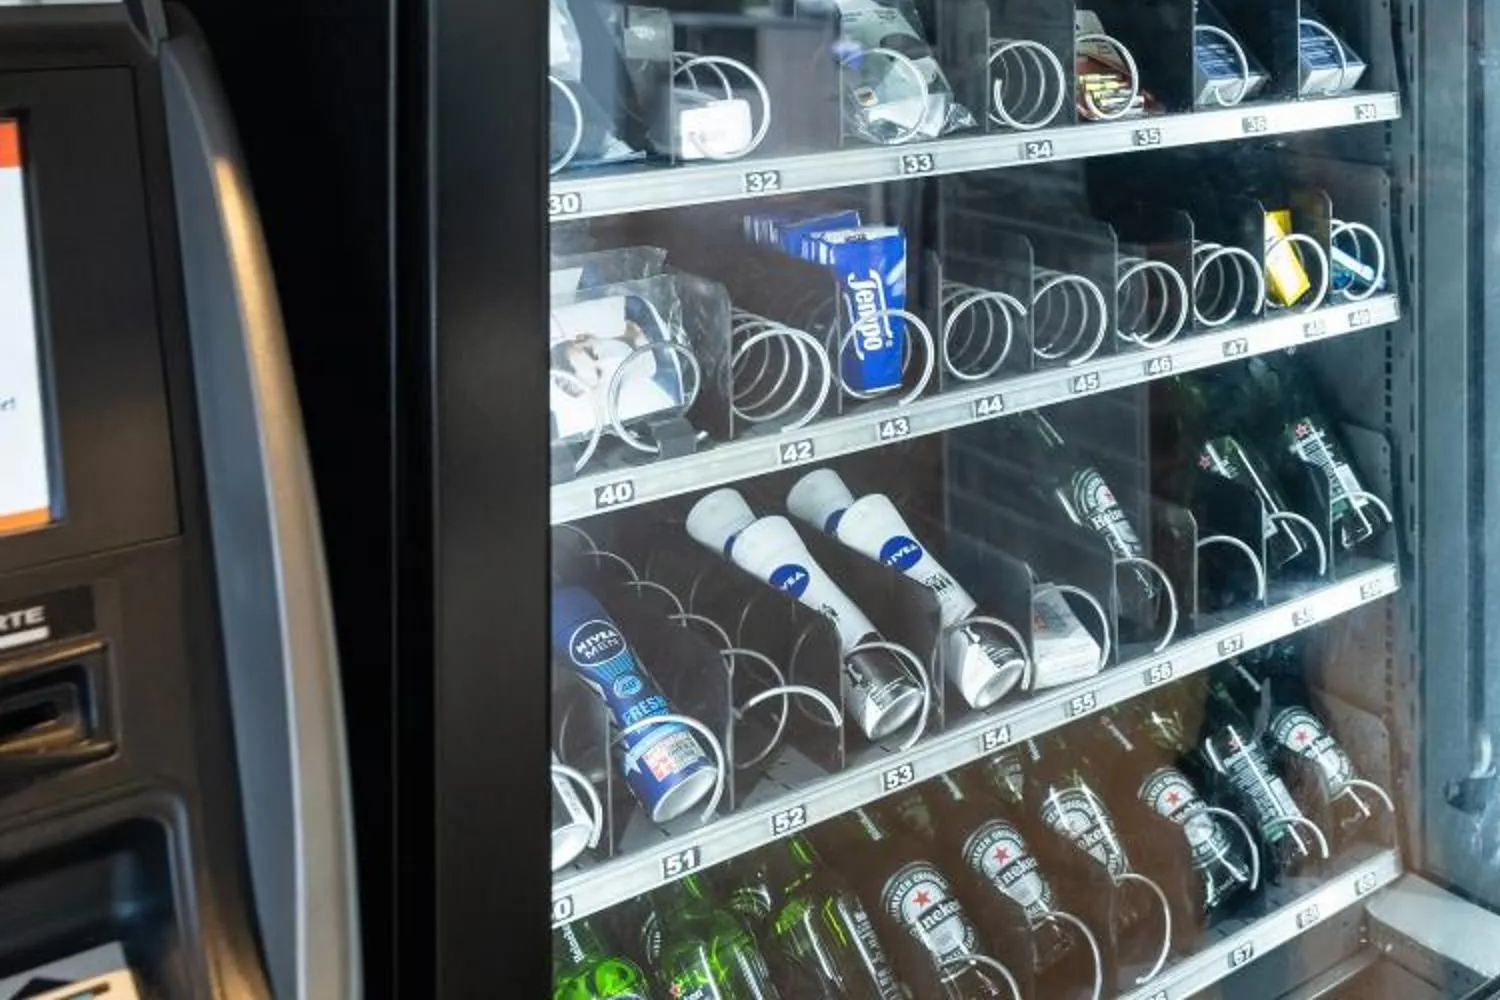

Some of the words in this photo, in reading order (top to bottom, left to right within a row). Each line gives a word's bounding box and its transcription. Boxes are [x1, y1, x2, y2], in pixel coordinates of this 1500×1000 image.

[1139, 130, 1160, 146] 35
[1026, 141, 1051, 158] 34
[904, 154, 934, 173] 33
[748, 173, 778, 192] 32
[548, 193, 580, 214] 30
[1226, 339, 1245, 354] 47
[1149, 359, 1170, 375] 46
[1075, 374, 1098, 393] 45
[977, 396, 1002, 416] 44
[881, 418, 908, 438] 43
[783, 442, 813, 462] 42
[600, 483, 633, 506] 40
[576, 629, 617, 654] NIVEA
[1072, 694, 1094, 715] 55
[985, 727, 1009, 749] 54
[886, 765, 913, 789] 53
[774, 807, 804, 834] 52
[665, 849, 696, 877] 51
[1003, 857, 1039, 884] neke
[554, 897, 572, 923] 0
[921, 899, 962, 930] neke
